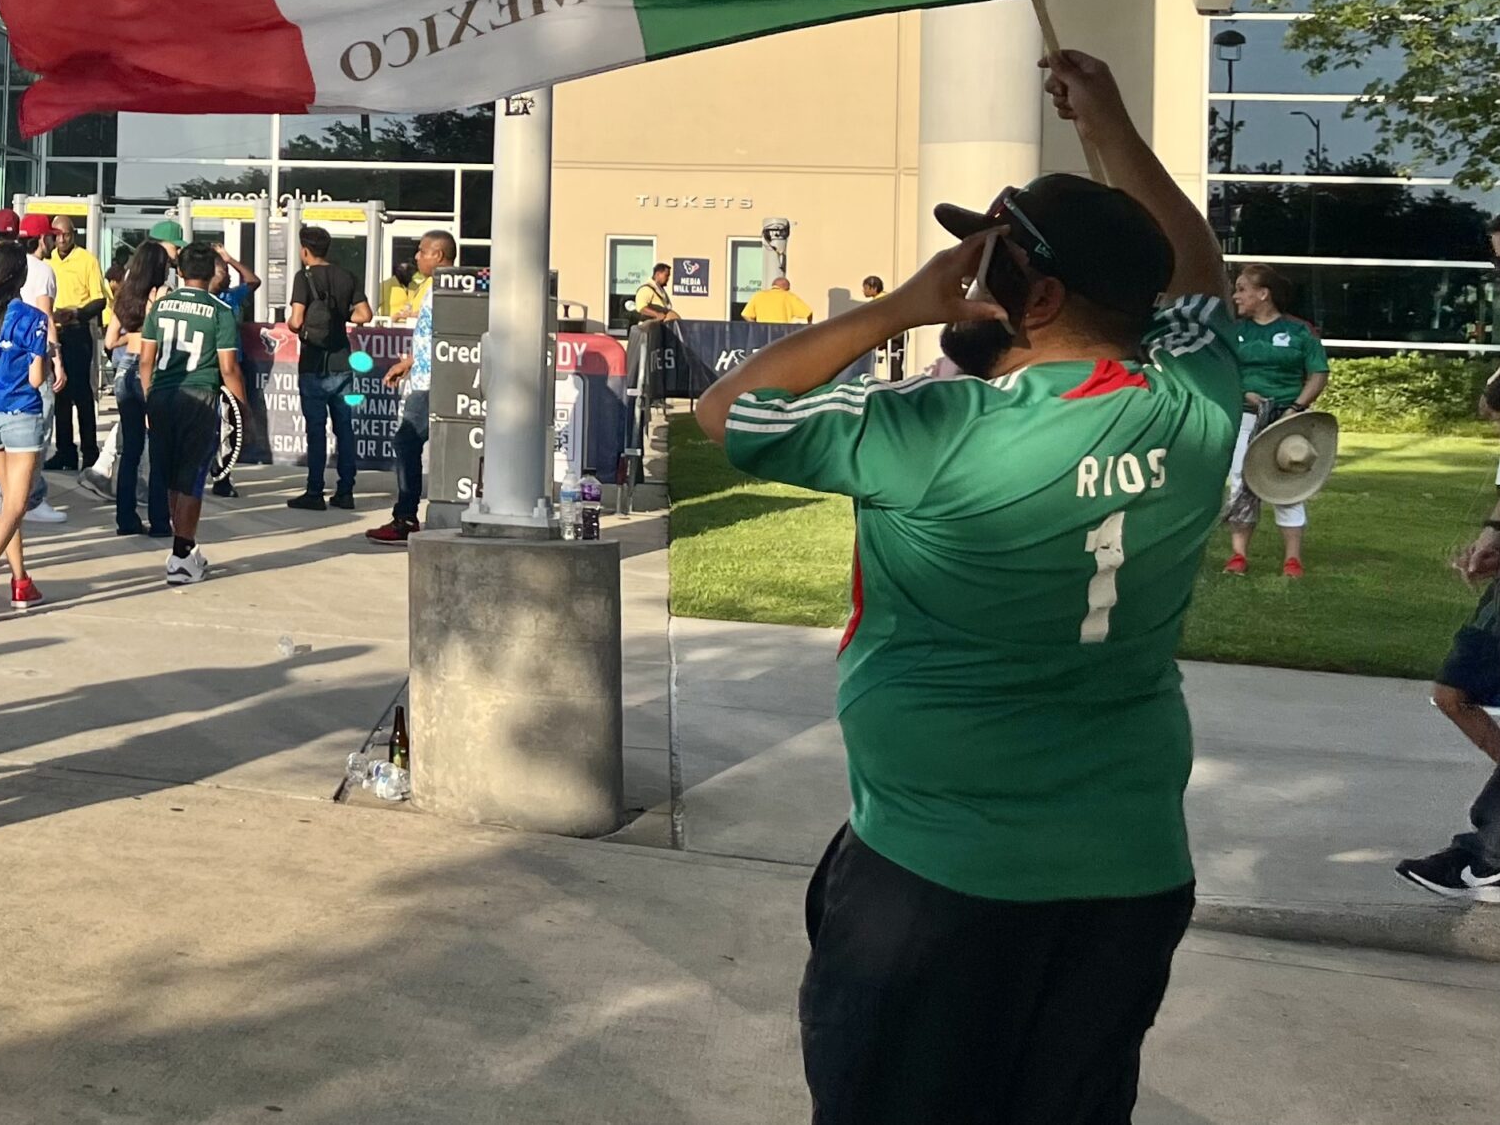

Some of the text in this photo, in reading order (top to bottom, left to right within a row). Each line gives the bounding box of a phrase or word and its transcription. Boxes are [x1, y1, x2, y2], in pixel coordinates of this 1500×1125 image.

[635, 194, 754, 209] TICKETS
[440, 272, 475, 293] nrg
[680, 277, 701, 286] MEDIA
[691, 285, 708, 294] CALL
[158, 317, 204, 372] 14
[255, 373, 268, 389] IF
[357, 439, 377, 459] QR
[1076, 448, 1167, 497] RIOS
[1079, 511, 1126, 644] 1
